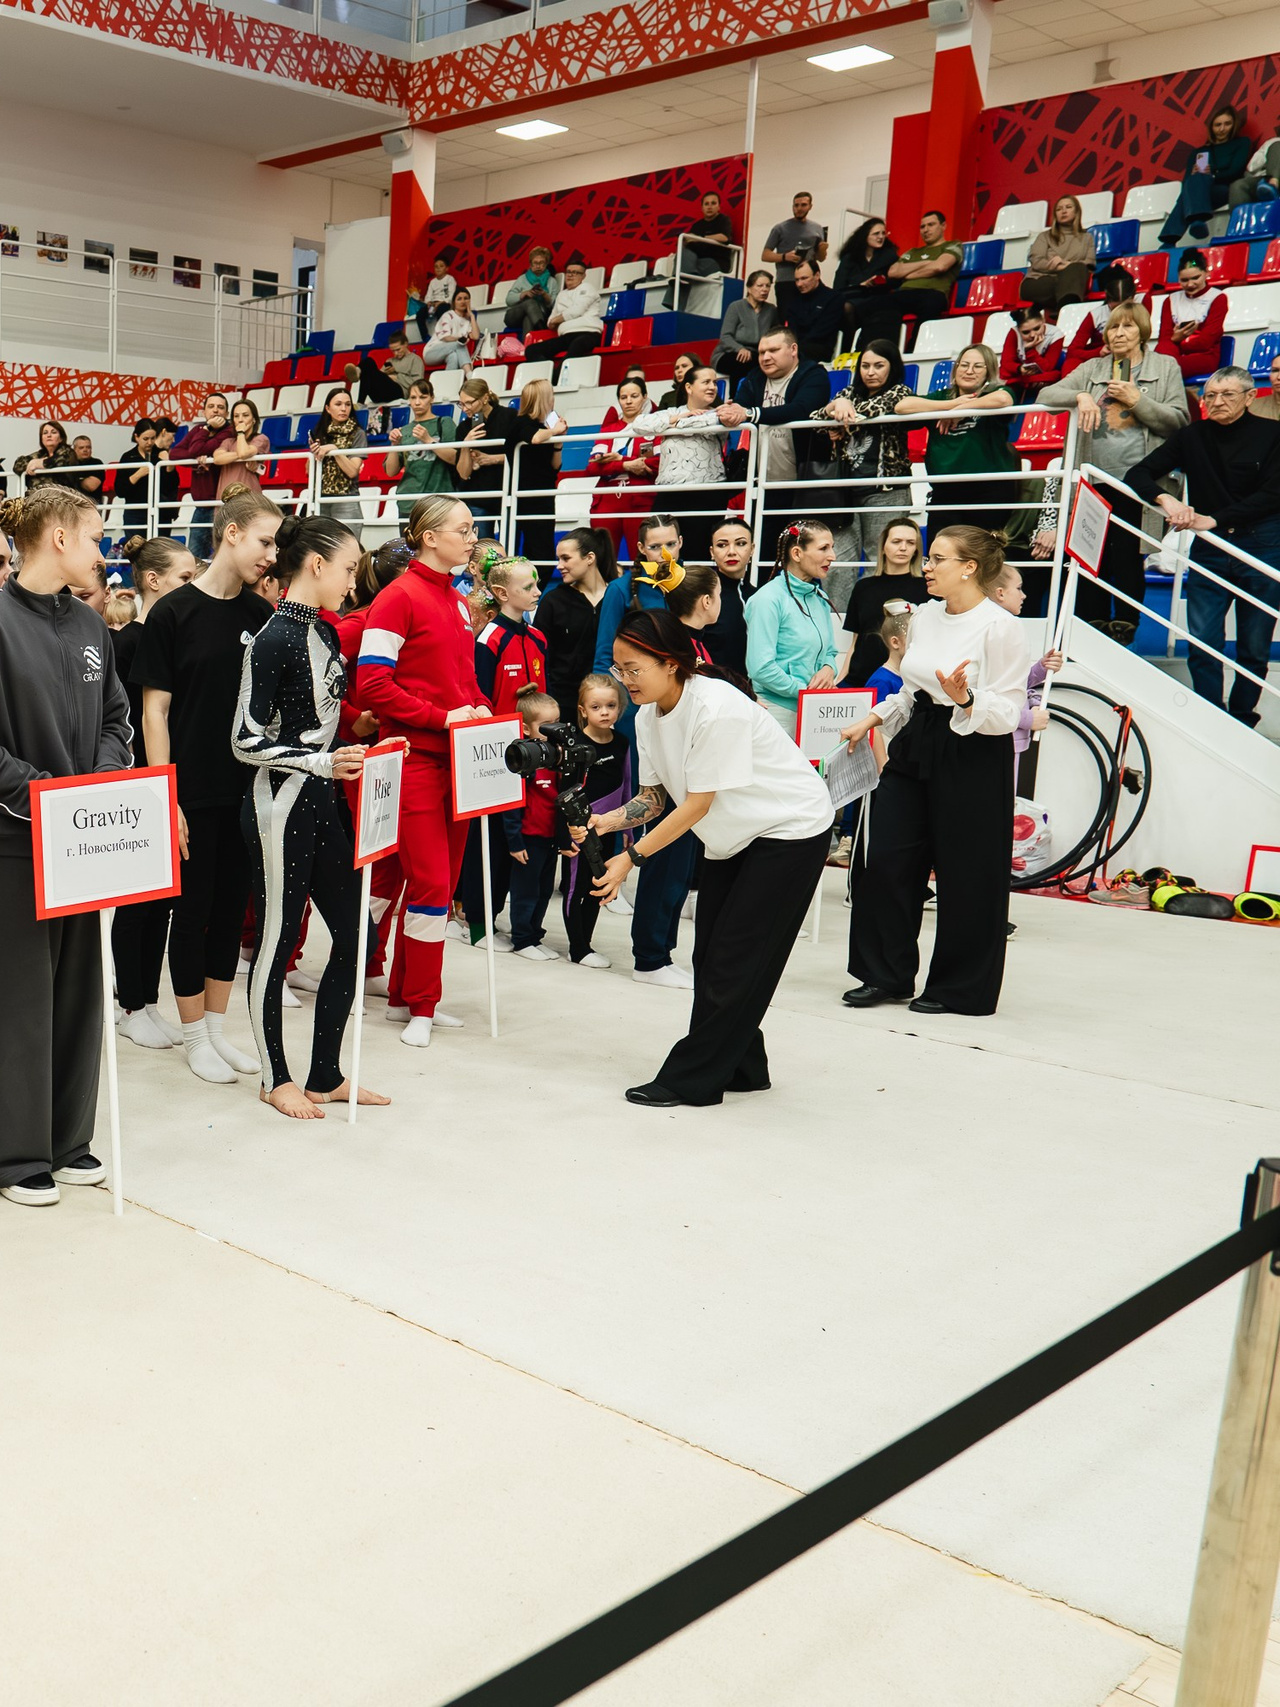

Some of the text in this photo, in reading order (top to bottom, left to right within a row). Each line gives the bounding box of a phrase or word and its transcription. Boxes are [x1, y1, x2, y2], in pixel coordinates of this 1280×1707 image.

[818, 706, 857, 719] SPIRIT
[473, 742, 505, 762] MINT
[374, 778, 392, 801] Rise
[73, 804, 142, 830] Gravity
[66, 838, 150, 857] г. Новосибирск
